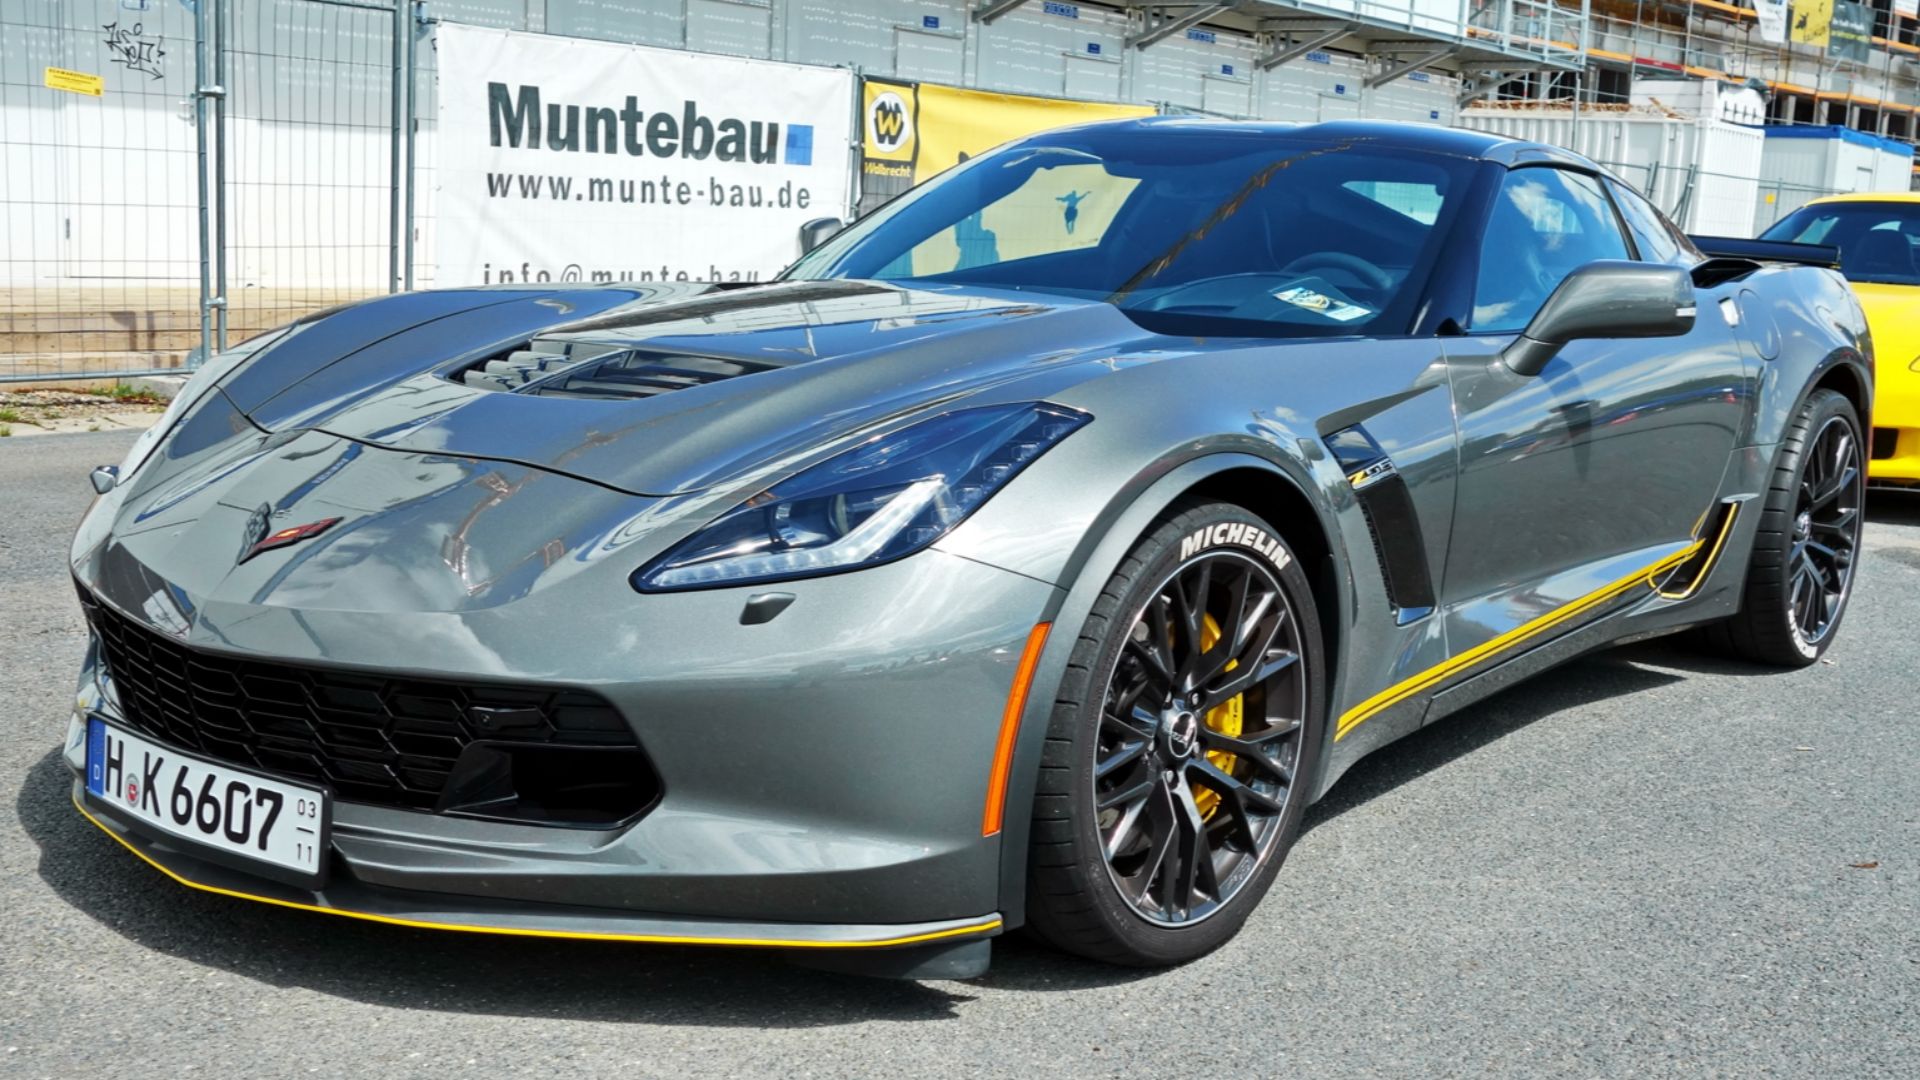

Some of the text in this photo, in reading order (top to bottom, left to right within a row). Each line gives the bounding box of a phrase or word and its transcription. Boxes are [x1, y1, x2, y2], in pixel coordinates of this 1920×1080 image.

[487, 81, 780, 165] Muntebau
[487, 172, 812, 209] www.munte-bau.de
[1179, 522, 1291, 570] MICHELIN
[170, 765, 283, 851] 6607
[297, 798, 317, 818] 03
[296, 843, 313, 863] 11
